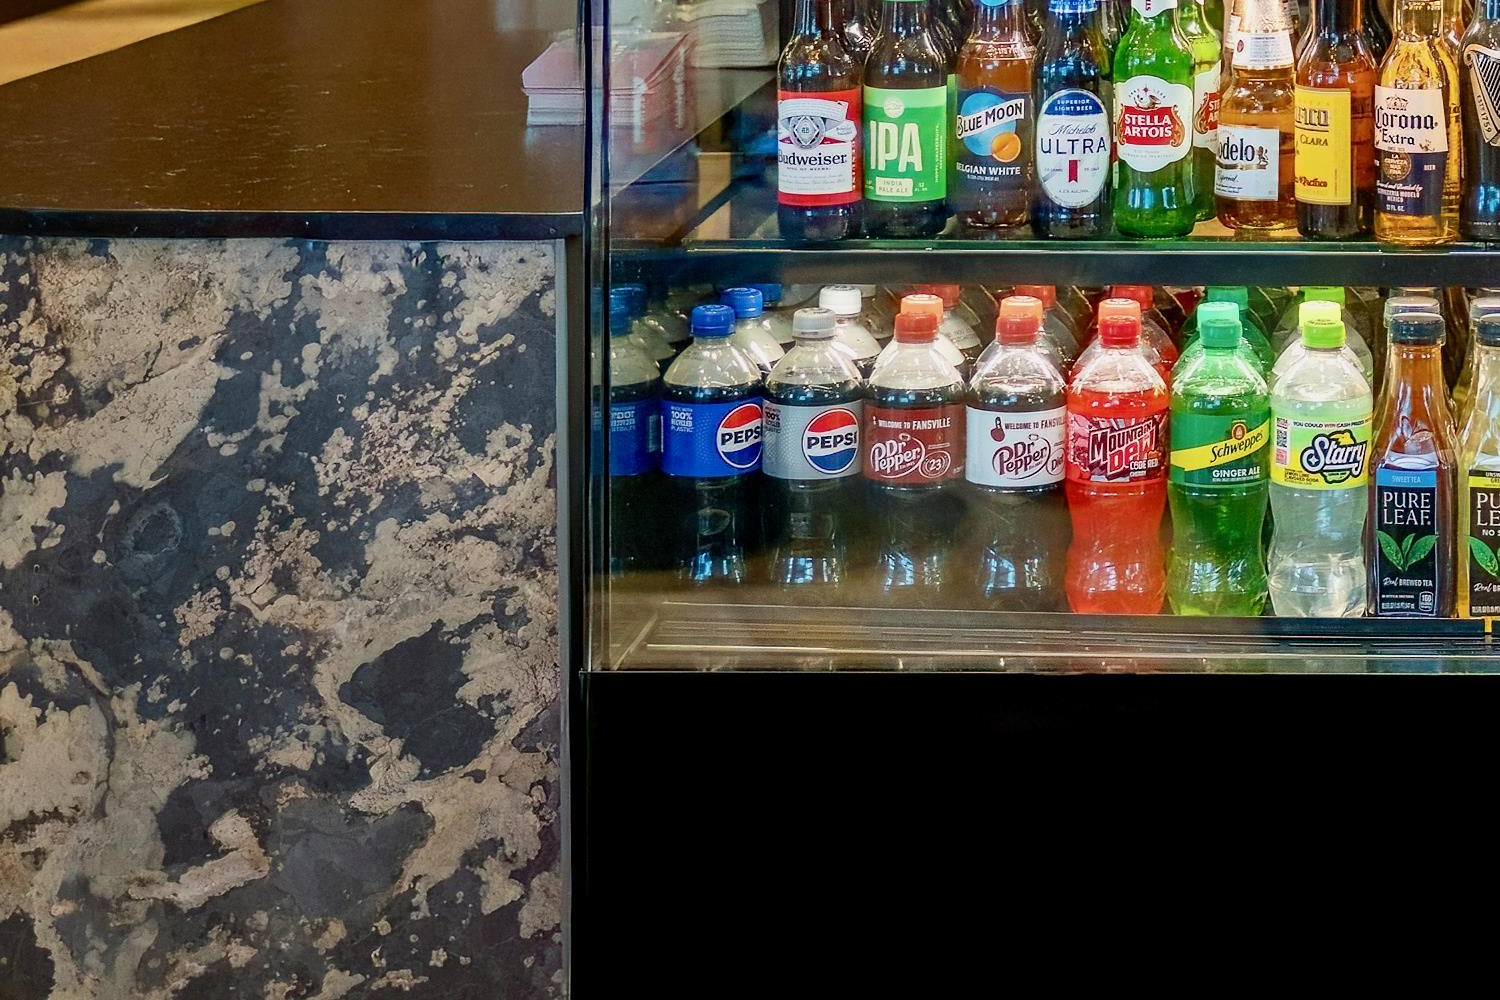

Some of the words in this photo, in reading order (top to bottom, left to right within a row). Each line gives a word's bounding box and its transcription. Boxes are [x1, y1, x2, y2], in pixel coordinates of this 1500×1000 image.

[957, 115, 983, 137] BLUE
[985, 102, 1023, 126] MOON
[1124, 114, 1172, 126] STELLA
[1375, 105, 1435, 130] Corona
[1481, 112, 1492, 132] 1759
[1050, 123, 1097, 136] Michelob
[1124, 126, 1172, 138] ARTOIS
[1380, 128, 1415, 145] Extra
[870, 120, 923, 172] IPA
[1041, 136, 1107, 155] ULTRA
[1300, 134, 1328, 146] CLARA
[778, 151, 846, 166] Budweiser
[989, 166, 1021, 175] WHITE
[671, 411, 693, 420] 100%
[878, 419, 903, 429] WELCOME
[912, 417, 951, 431] FANSVILLE
[807, 434, 858, 449] PEPSI
[884, 439, 905, 456] Dr
[1210, 432, 1264, 463] Schweppes
[871, 442, 920, 473] Pepper
[1014, 442, 1035, 459] Dr
[1302, 435, 1367, 478] Starry
[929, 458, 942, 471] 23
[992, 446, 1047, 475] Pepper
[1130, 460, 1146, 470] CODE
[1148, 458, 1158, 468] RED
[1212, 469, 1247, 478] GINGER
[1248, 466, 1260, 475] ALE
[1392, 475, 1411, 483] SWEET
[1383, 492, 1431, 509] PURE
[1482, 529, 1495, 537] NO
[1382, 577, 1398, 587] Real
[1399, 579, 1422, 587] BREWED
[1474, 582, 1492, 593] Real
